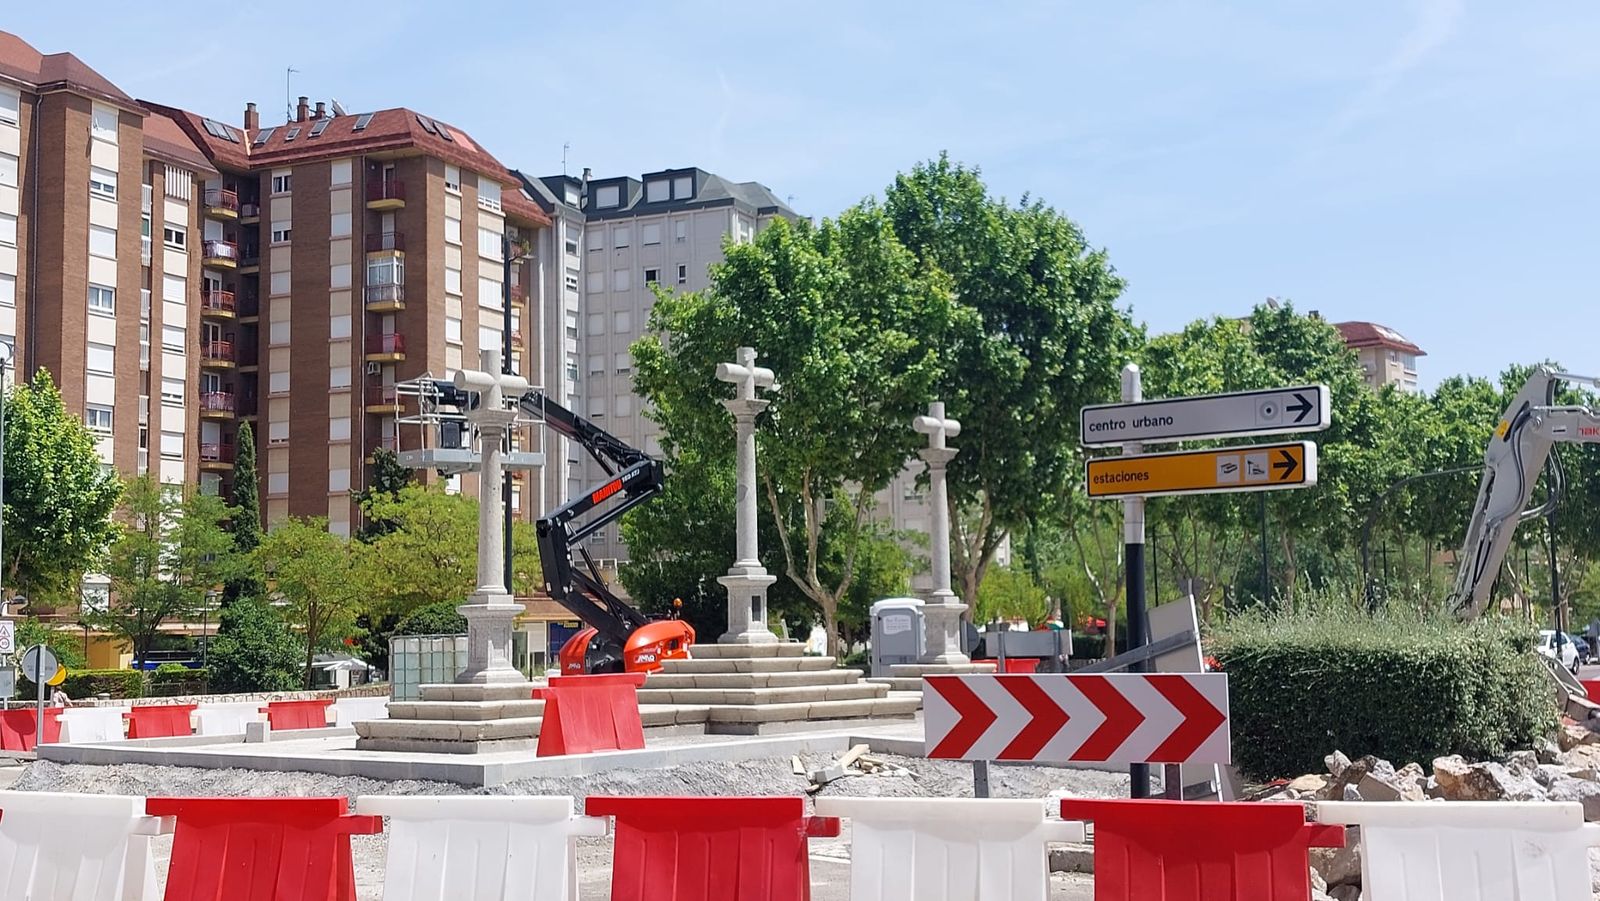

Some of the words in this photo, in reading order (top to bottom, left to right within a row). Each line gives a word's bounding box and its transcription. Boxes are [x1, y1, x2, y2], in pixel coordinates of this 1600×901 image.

[1089, 419, 1126, 432] centro
[1132, 415, 1174, 428] urbano
[1093, 470, 1150, 484] estaciones
